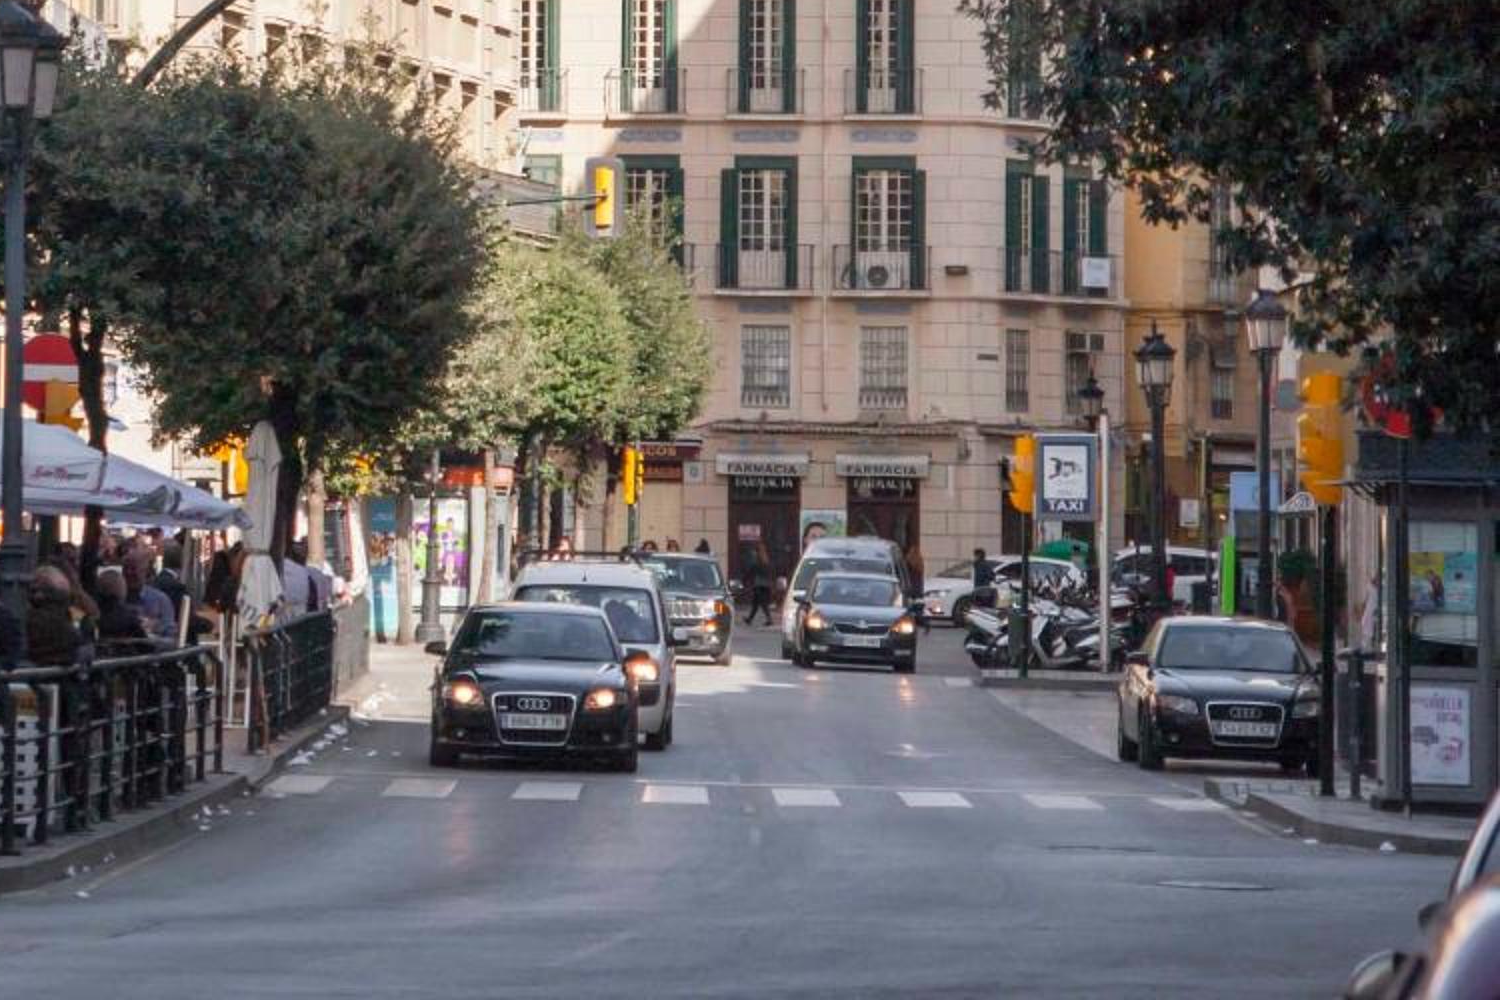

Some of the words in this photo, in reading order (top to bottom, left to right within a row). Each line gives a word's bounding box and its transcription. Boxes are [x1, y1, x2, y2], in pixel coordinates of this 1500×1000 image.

[727, 462, 798, 475] FARMACIA
[846, 463, 917, 476] FARMACIA
[1047, 499, 1085, 512] TAXI
